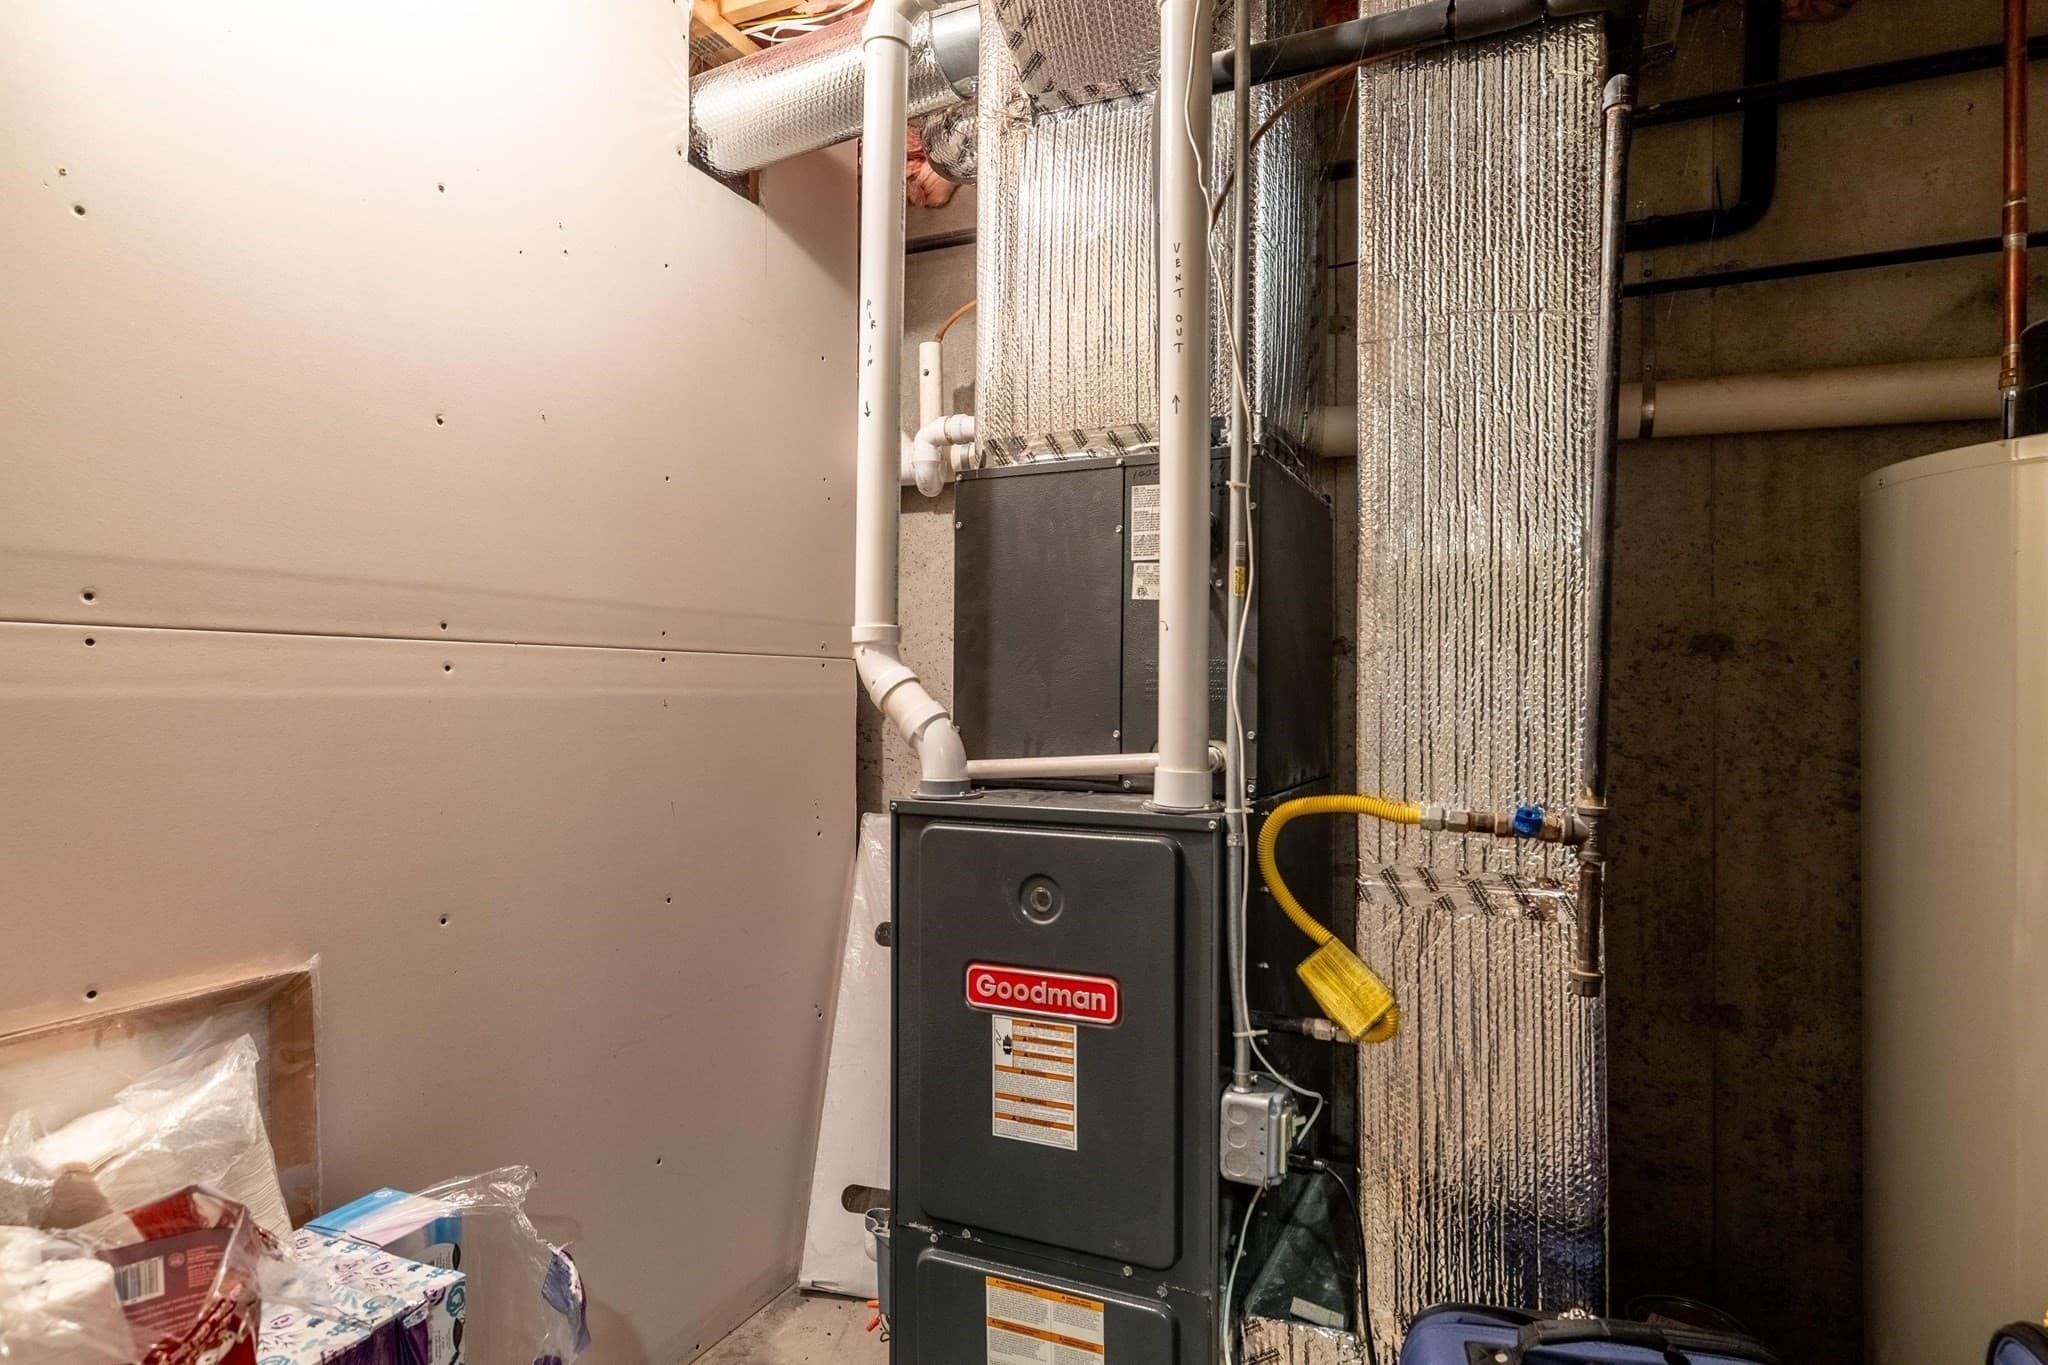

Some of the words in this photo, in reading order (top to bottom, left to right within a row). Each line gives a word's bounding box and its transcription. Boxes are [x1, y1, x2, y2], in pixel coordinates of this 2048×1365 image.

[1173, 242, 1184, 298] VENT
[1173, 314, 1184, 352] OUT
[976, 974, 1107, 1012] Goodman
